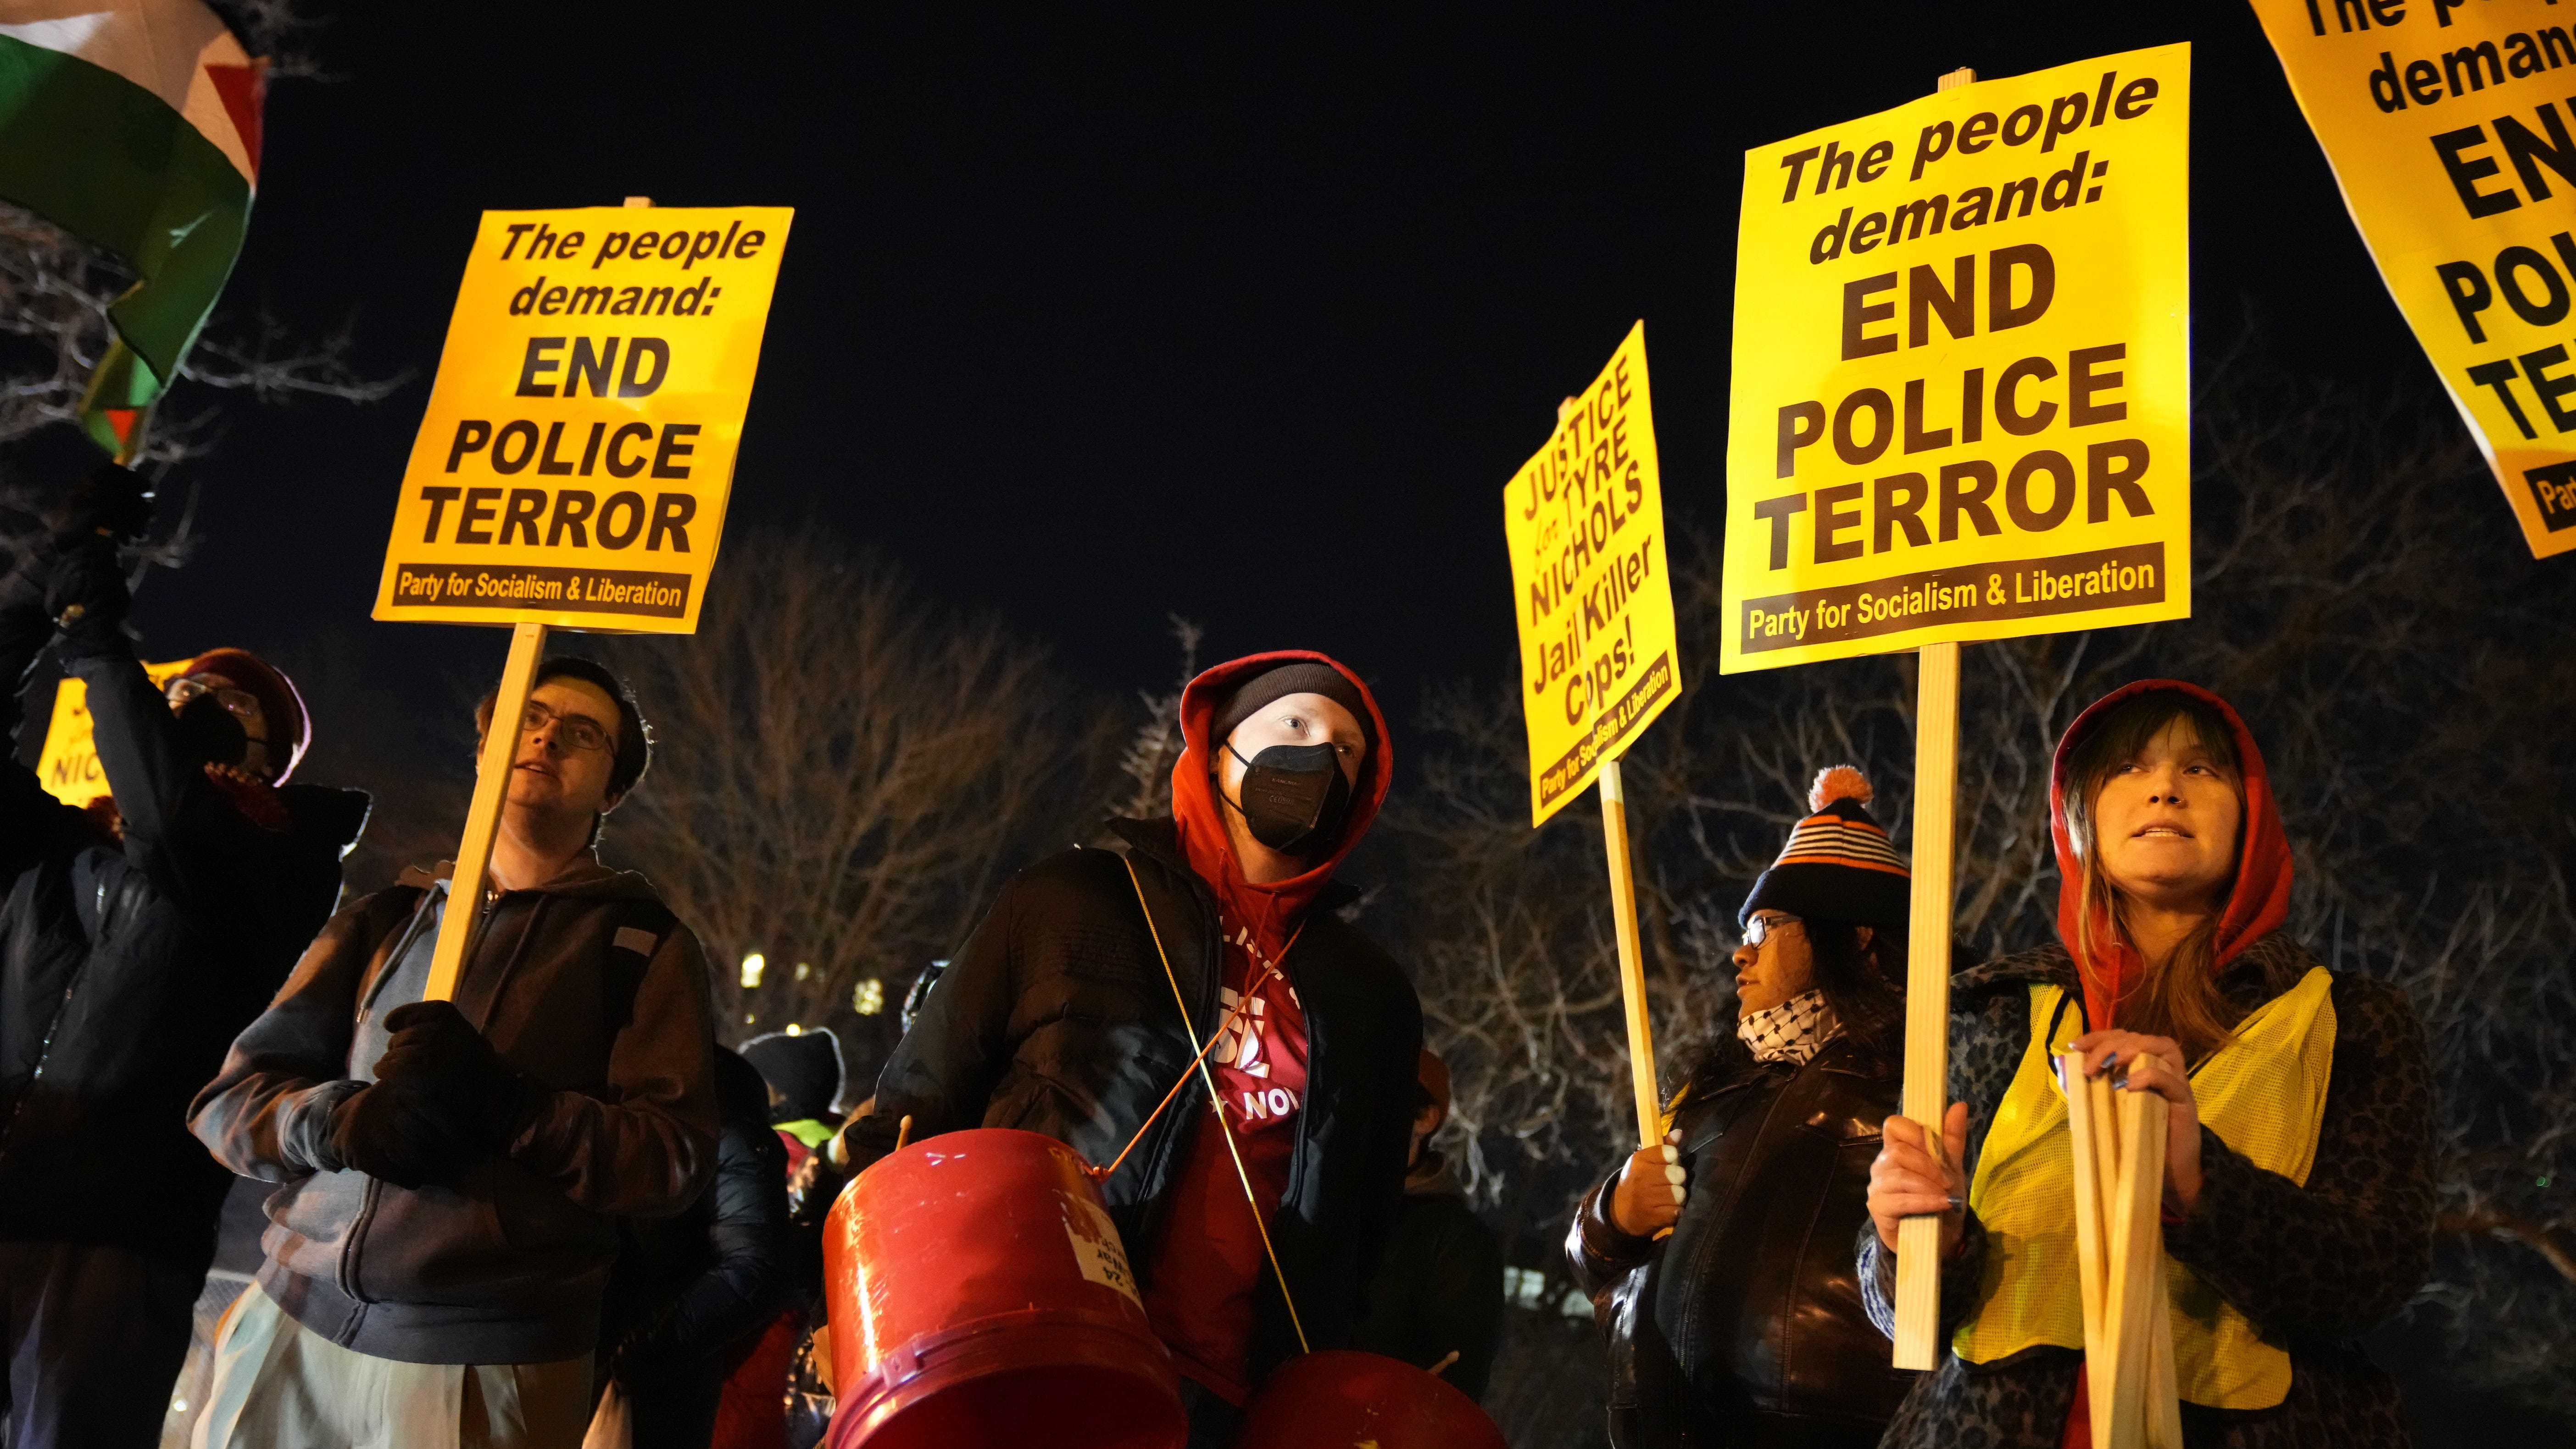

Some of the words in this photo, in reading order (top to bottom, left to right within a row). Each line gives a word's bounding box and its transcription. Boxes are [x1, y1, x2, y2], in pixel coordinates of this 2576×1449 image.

[2370, 18, 2576, 113] deman
[1780, 141, 1893, 203] The
[1909, 71, 2159, 182] people
[2430, 96, 2576, 220] EN
[501, 224, 584, 260] The
[592, 221, 765, 269] people
[1810, 150, 2109, 264] demand:
[509, 276, 721, 316] demand:
[1842, 244, 2055, 361] END
[515, 337, 669, 397] END
[1777, 343, 2126, 479] POLICE
[2465, 339, 2576, 440] TE
[445, 420, 701, 479] POLICE
[1525, 355, 1631, 520] JUSTICE
[1563, 415, 1628, 507] TYRE
[420, 486, 696, 552] TERROR
[1531, 460, 1642, 626] NICHOLS
[1754, 439, 2155, 571] TERROR
[399, 572, 444, 601] Party
[447, 572, 473, 596] for
[475, 573, 562, 599] Socialism
[567, 576, 580, 600] &
[585, 578, 681, 606] Liberation
[1534, 613, 1580, 694] Jail
[1583, 535, 1651, 641] Killer
[1750, 606, 1809, 639] Party
[1816, 600, 1851, 629] for
[1858, 582, 1976, 623] Socialism
[1986, 574, 2006, 605] &
[2016, 563, 2154, 603] Liberation
[1566, 614, 1634, 725] Cops!
[1542, 767, 1566, 799] Party
[1567, 757, 1580, 779] for
[1619, 706, 1627, 728] &
[1627, 665, 1669, 720] Liberation
[1243, 1087, 1300, 1120] NO
